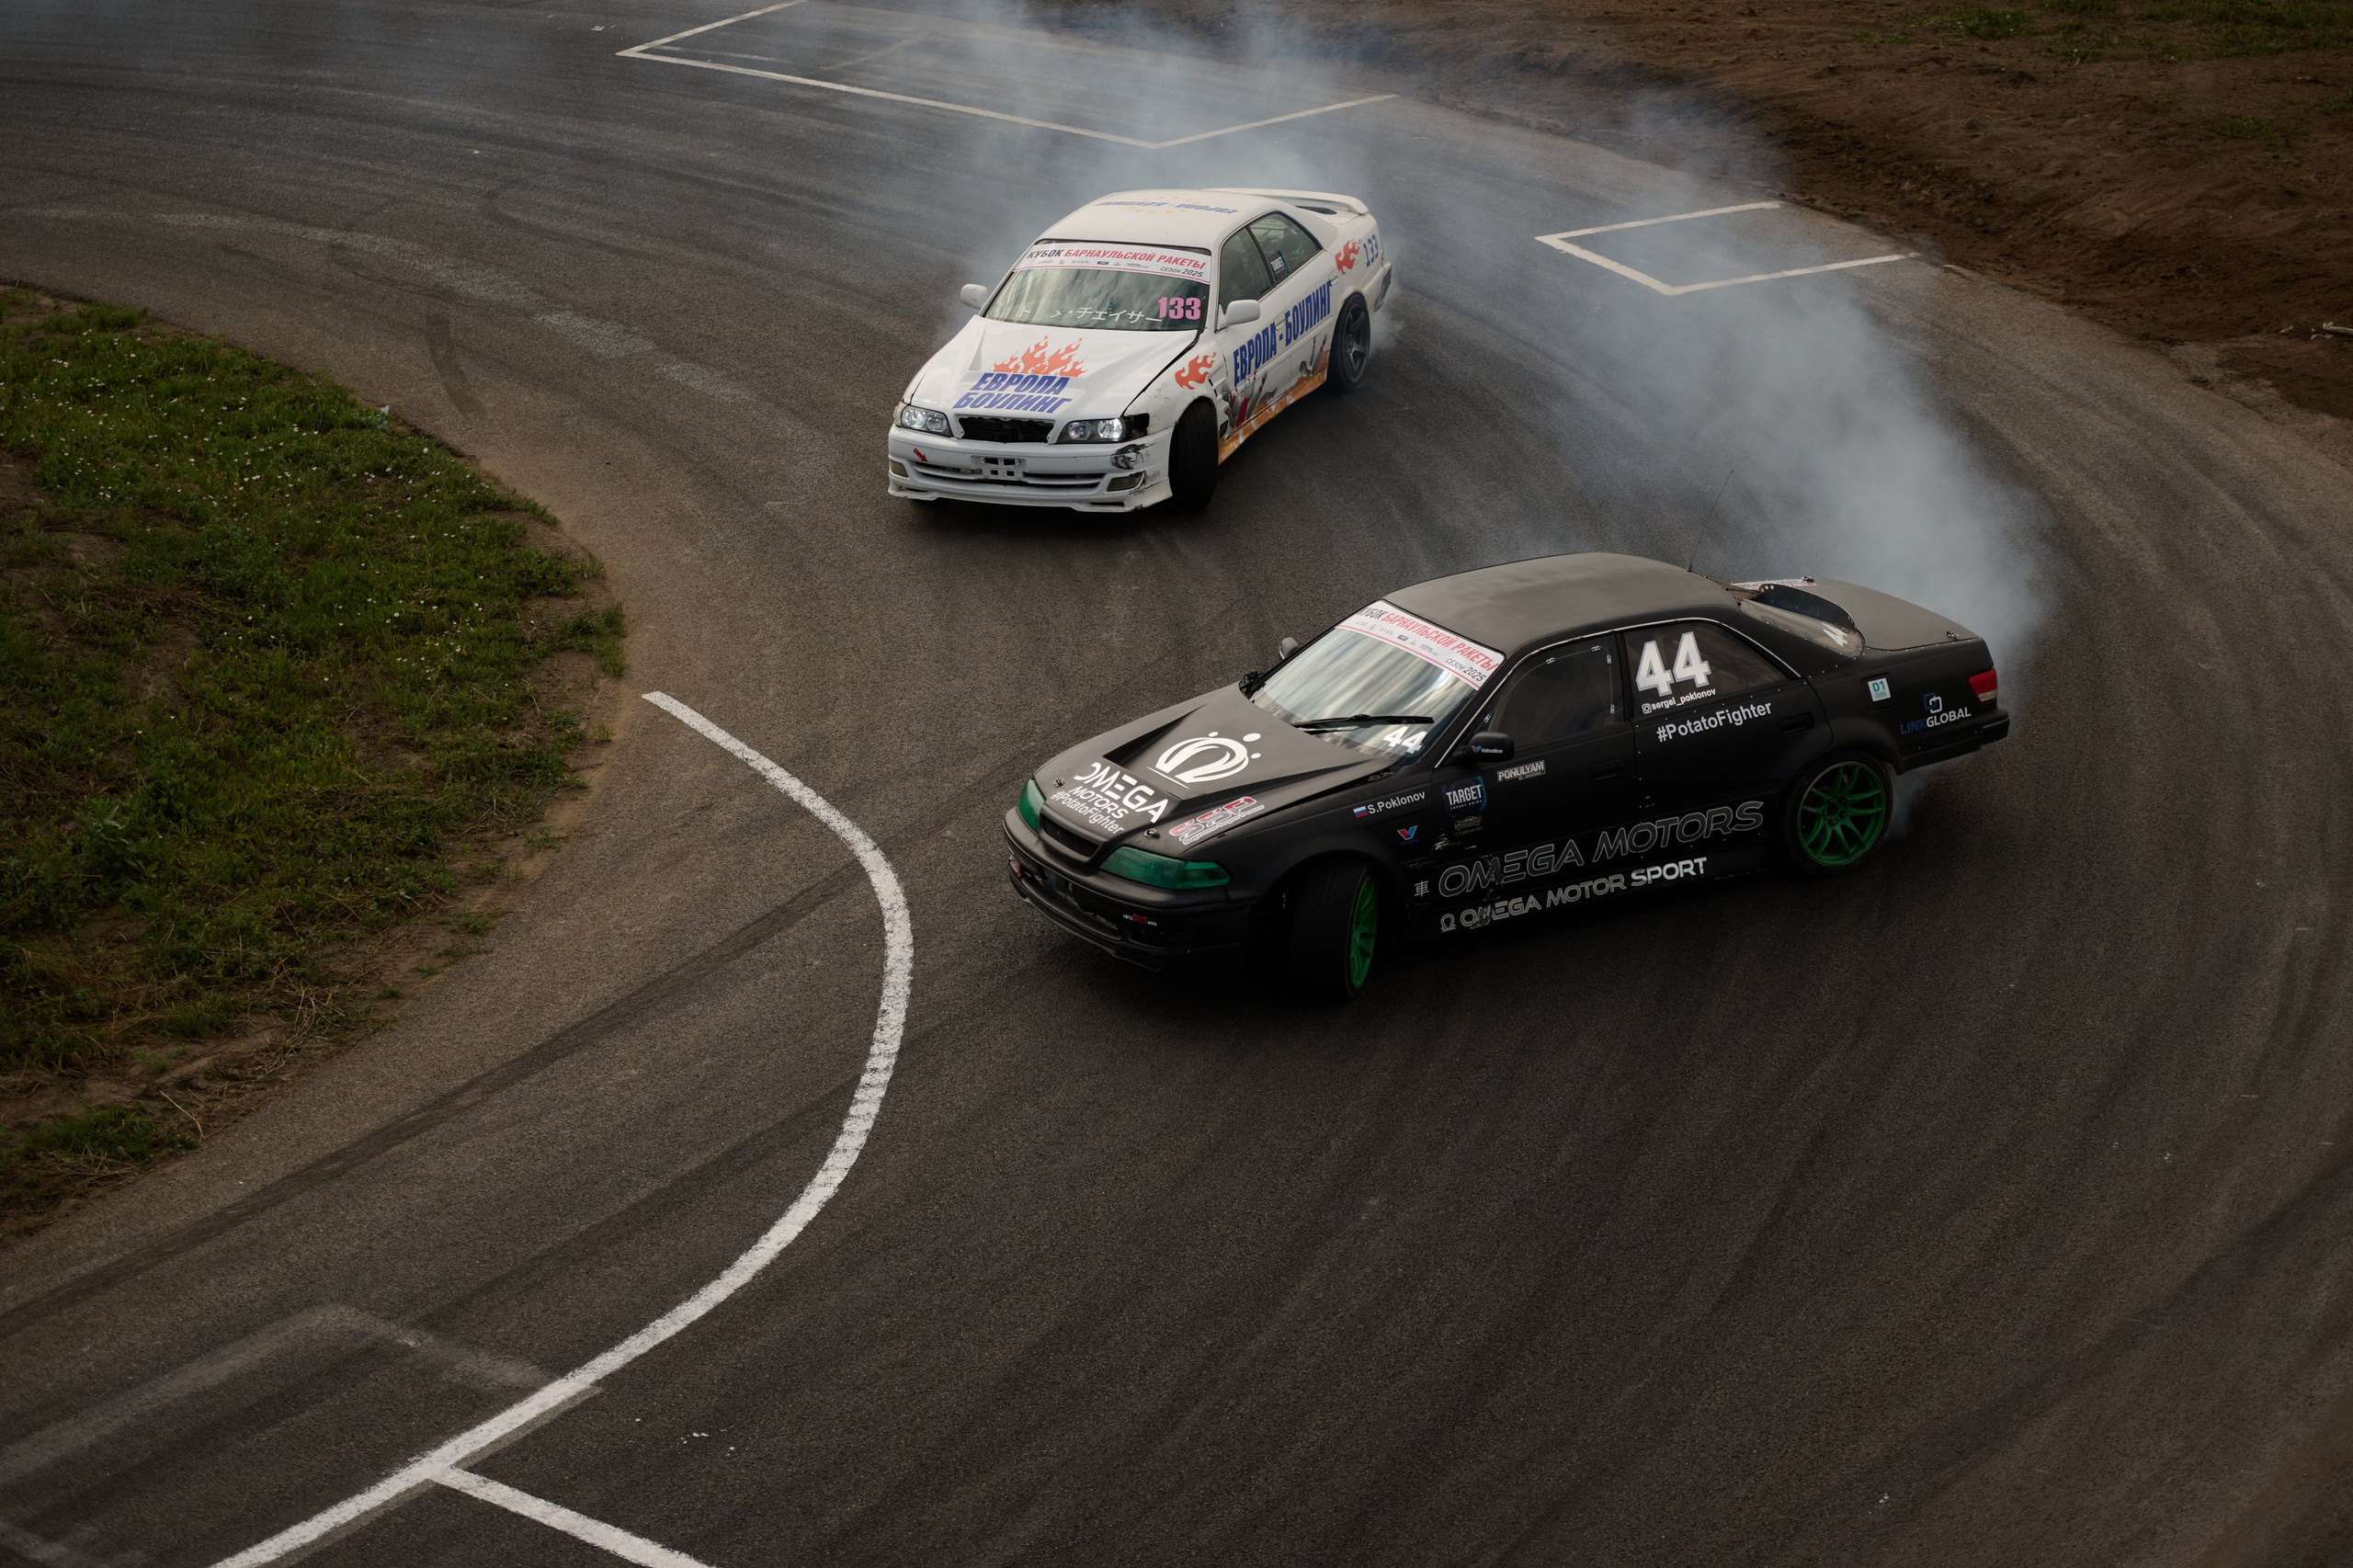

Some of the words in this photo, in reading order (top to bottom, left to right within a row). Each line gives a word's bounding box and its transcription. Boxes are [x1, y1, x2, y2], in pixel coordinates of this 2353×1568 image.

[1027, 249, 1063, 259] КУБОК
[1063, 249, 1156, 262] БАРНАУЛЬСКОЙ
[1156, 255, 1207, 269] РАКЕТЫ
[1363, 233, 1379, 267] 133
[1182, 268, 1204, 278] 2025
[1158, 297, 1200, 320] 133
[1233, 322, 1278, 386] ЕВРОПА
[1285, 279, 1333, 347] БОУЛИНГ
[970, 372, 1070, 395] ЕВРОПА
[952, 392, 1073, 414] БОУЛИНГ
[1381, 613, 1460, 648] БАРНАУЛЬСКОЙ
[1454, 642, 1500, 672] РАКЕТЫ
[1462, 666, 1487, 682] 2025
[1635, 631, 1712, 698] 44
[1872, 681, 1885, 692] D1
[1656, 701, 1772, 743] #PotatoFighter
[1382, 726, 1428, 754] 44
[1498, 761, 1545, 781] PONULYAM
[1068, 785, 1130, 819] MOTORS
[1073, 762, 1169, 824] OMEGA
[1368, 791, 1426, 814] S.Poklonov
[1446, 785, 1483, 806] TARGET
[1050, 790, 1124, 835] #PotatoFighter
[1438, 839, 1585, 897] OMEGA
[1592, 801, 1764, 863] MOTORS
[1415, 881, 1429, 897] 車
[1546, 873, 1627, 908] MOTOR
[1631, 857, 1708, 887] SPORT
